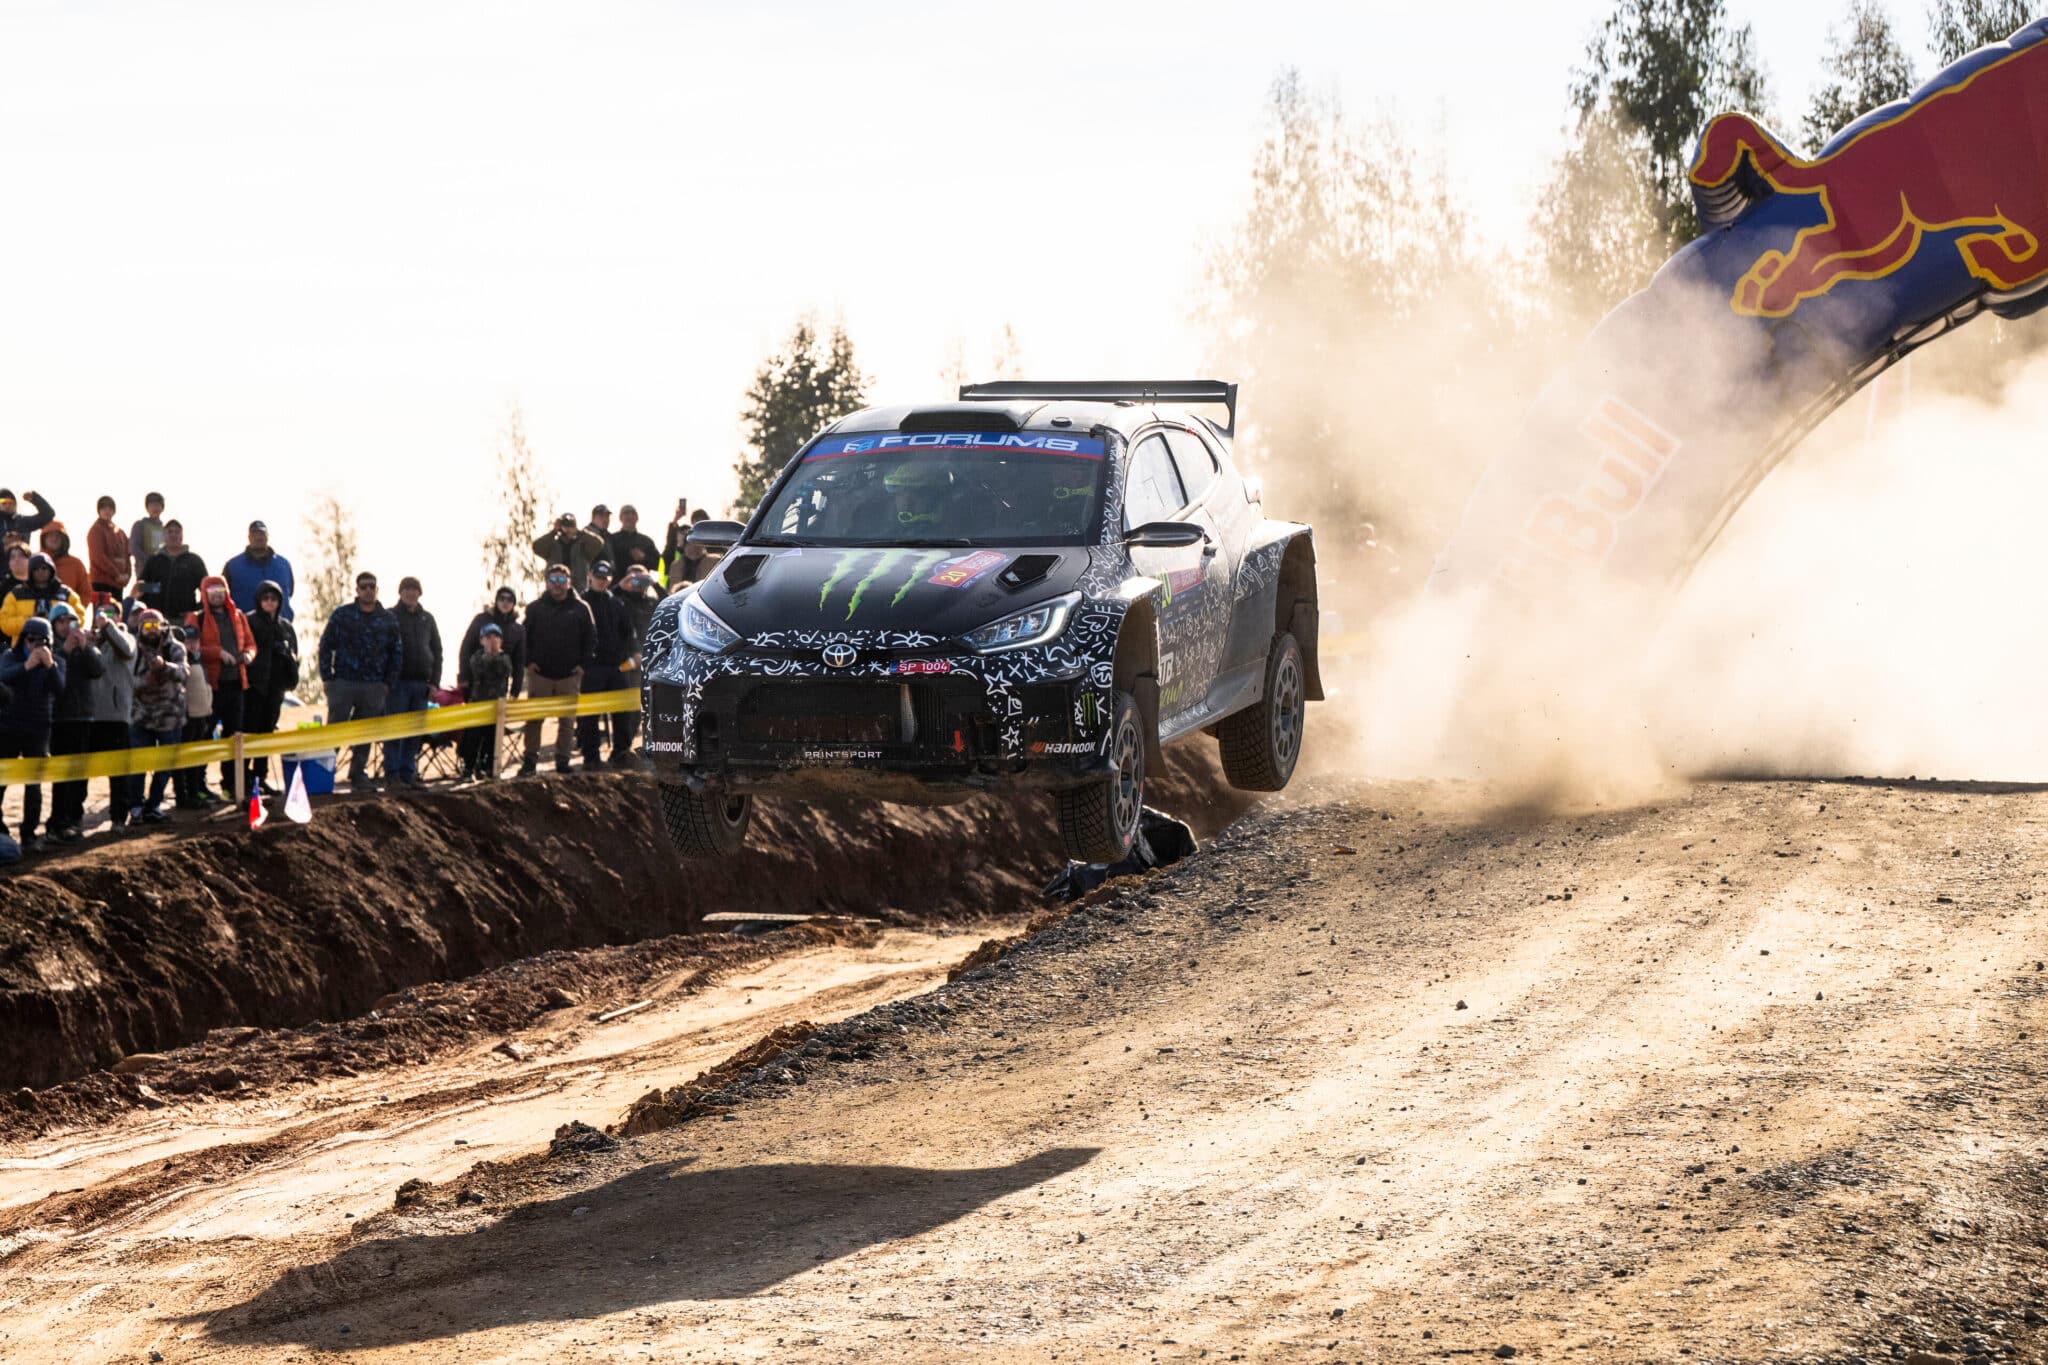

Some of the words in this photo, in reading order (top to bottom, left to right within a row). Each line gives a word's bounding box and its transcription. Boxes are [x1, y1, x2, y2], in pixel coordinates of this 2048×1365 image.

[878, 433, 1078, 451] FORUM8
[1521, 394, 1682, 562] Bull
[939, 570, 967, 583] 20
[899, 662, 917, 671] SP
[921, 662, 948, 671] 1004
[804, 751, 883, 759] PRINTSPORT
